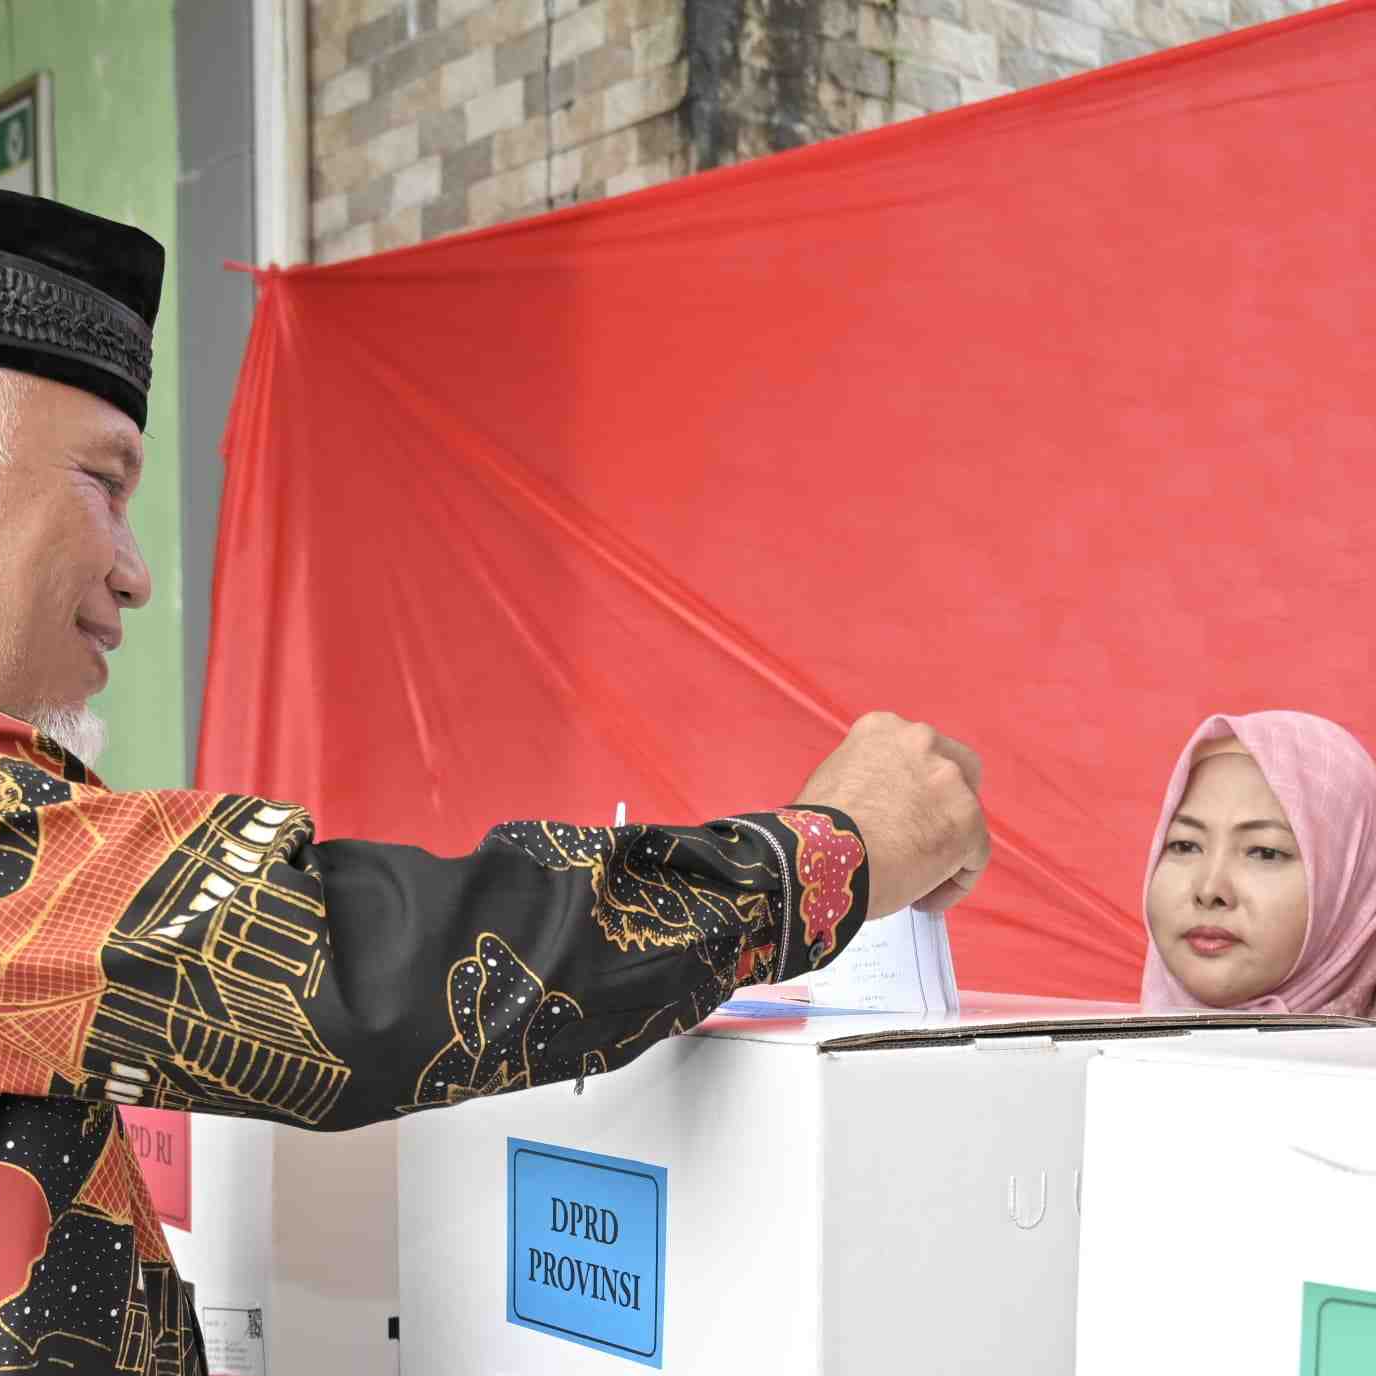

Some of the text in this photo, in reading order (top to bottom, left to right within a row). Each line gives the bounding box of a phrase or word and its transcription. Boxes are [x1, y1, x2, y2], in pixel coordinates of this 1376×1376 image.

[156, 1129, 174, 1167] RI
[550, 1196, 619, 1246] DPRD
[528, 1247, 641, 1311] PROVINSI
